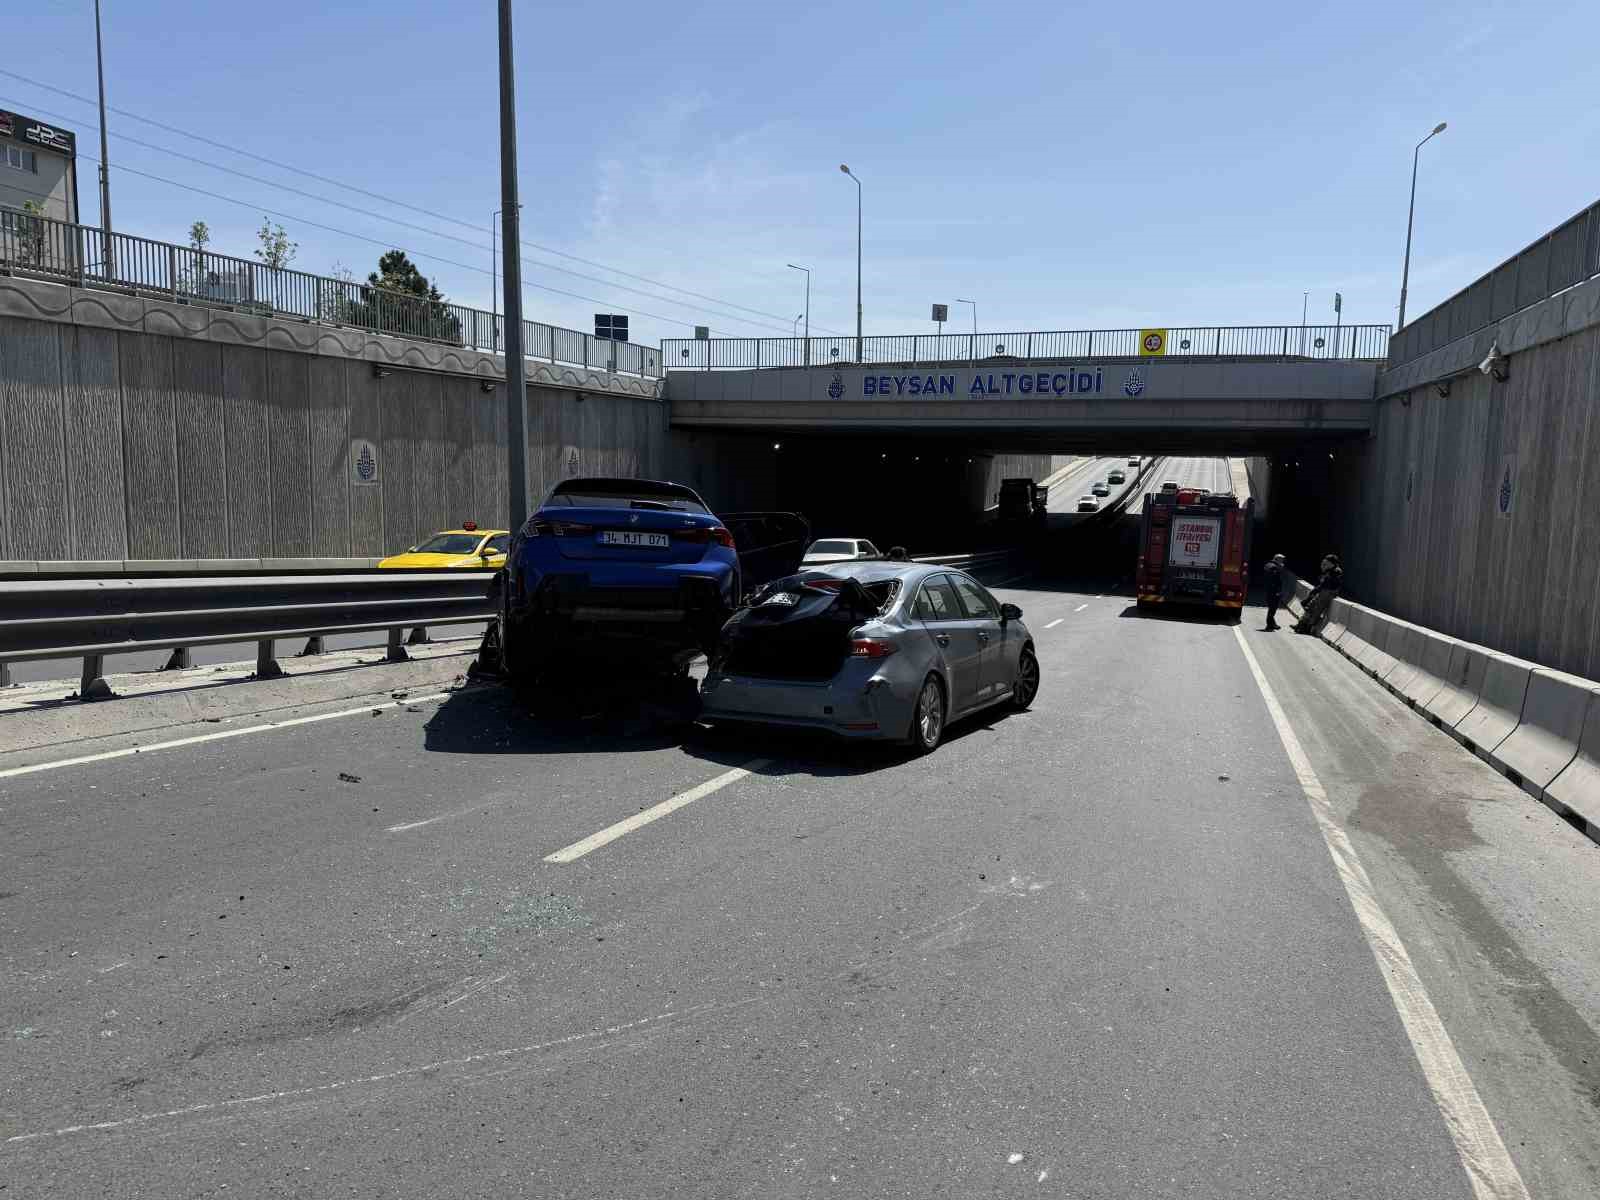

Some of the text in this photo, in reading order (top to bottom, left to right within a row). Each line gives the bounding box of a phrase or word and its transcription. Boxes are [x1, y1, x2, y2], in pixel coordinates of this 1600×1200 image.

[864, 368, 1102, 395] BEYSAN ALTGEÇİDİ
[649, 534, 667, 546] 071
